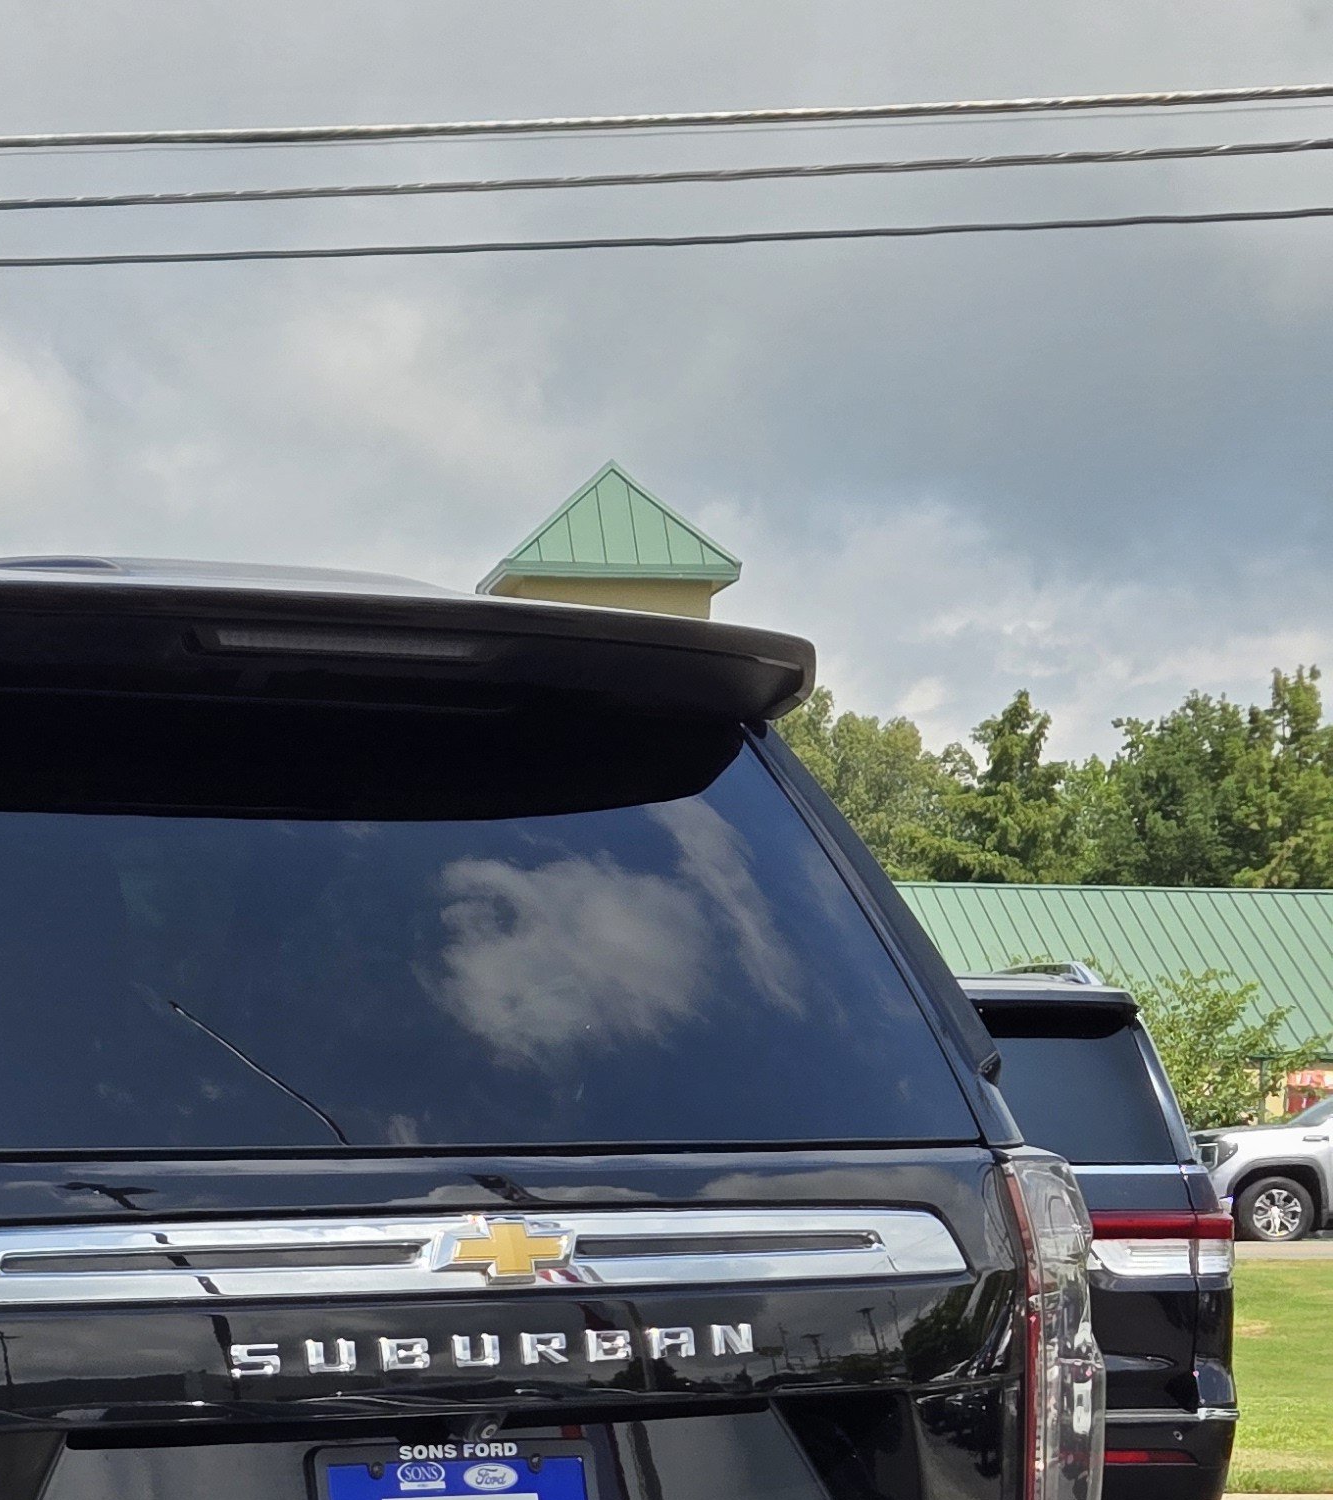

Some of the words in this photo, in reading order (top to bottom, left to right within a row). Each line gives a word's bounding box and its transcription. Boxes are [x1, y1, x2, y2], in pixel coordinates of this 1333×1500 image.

[229, 1322, 754, 1377] SUBURBAN
[399, 1443, 458, 1460] SONS
[462, 1442, 518, 1458] FORD
[404, 1465, 439, 1481] SONS
[475, 1467, 507, 1485] Ford
